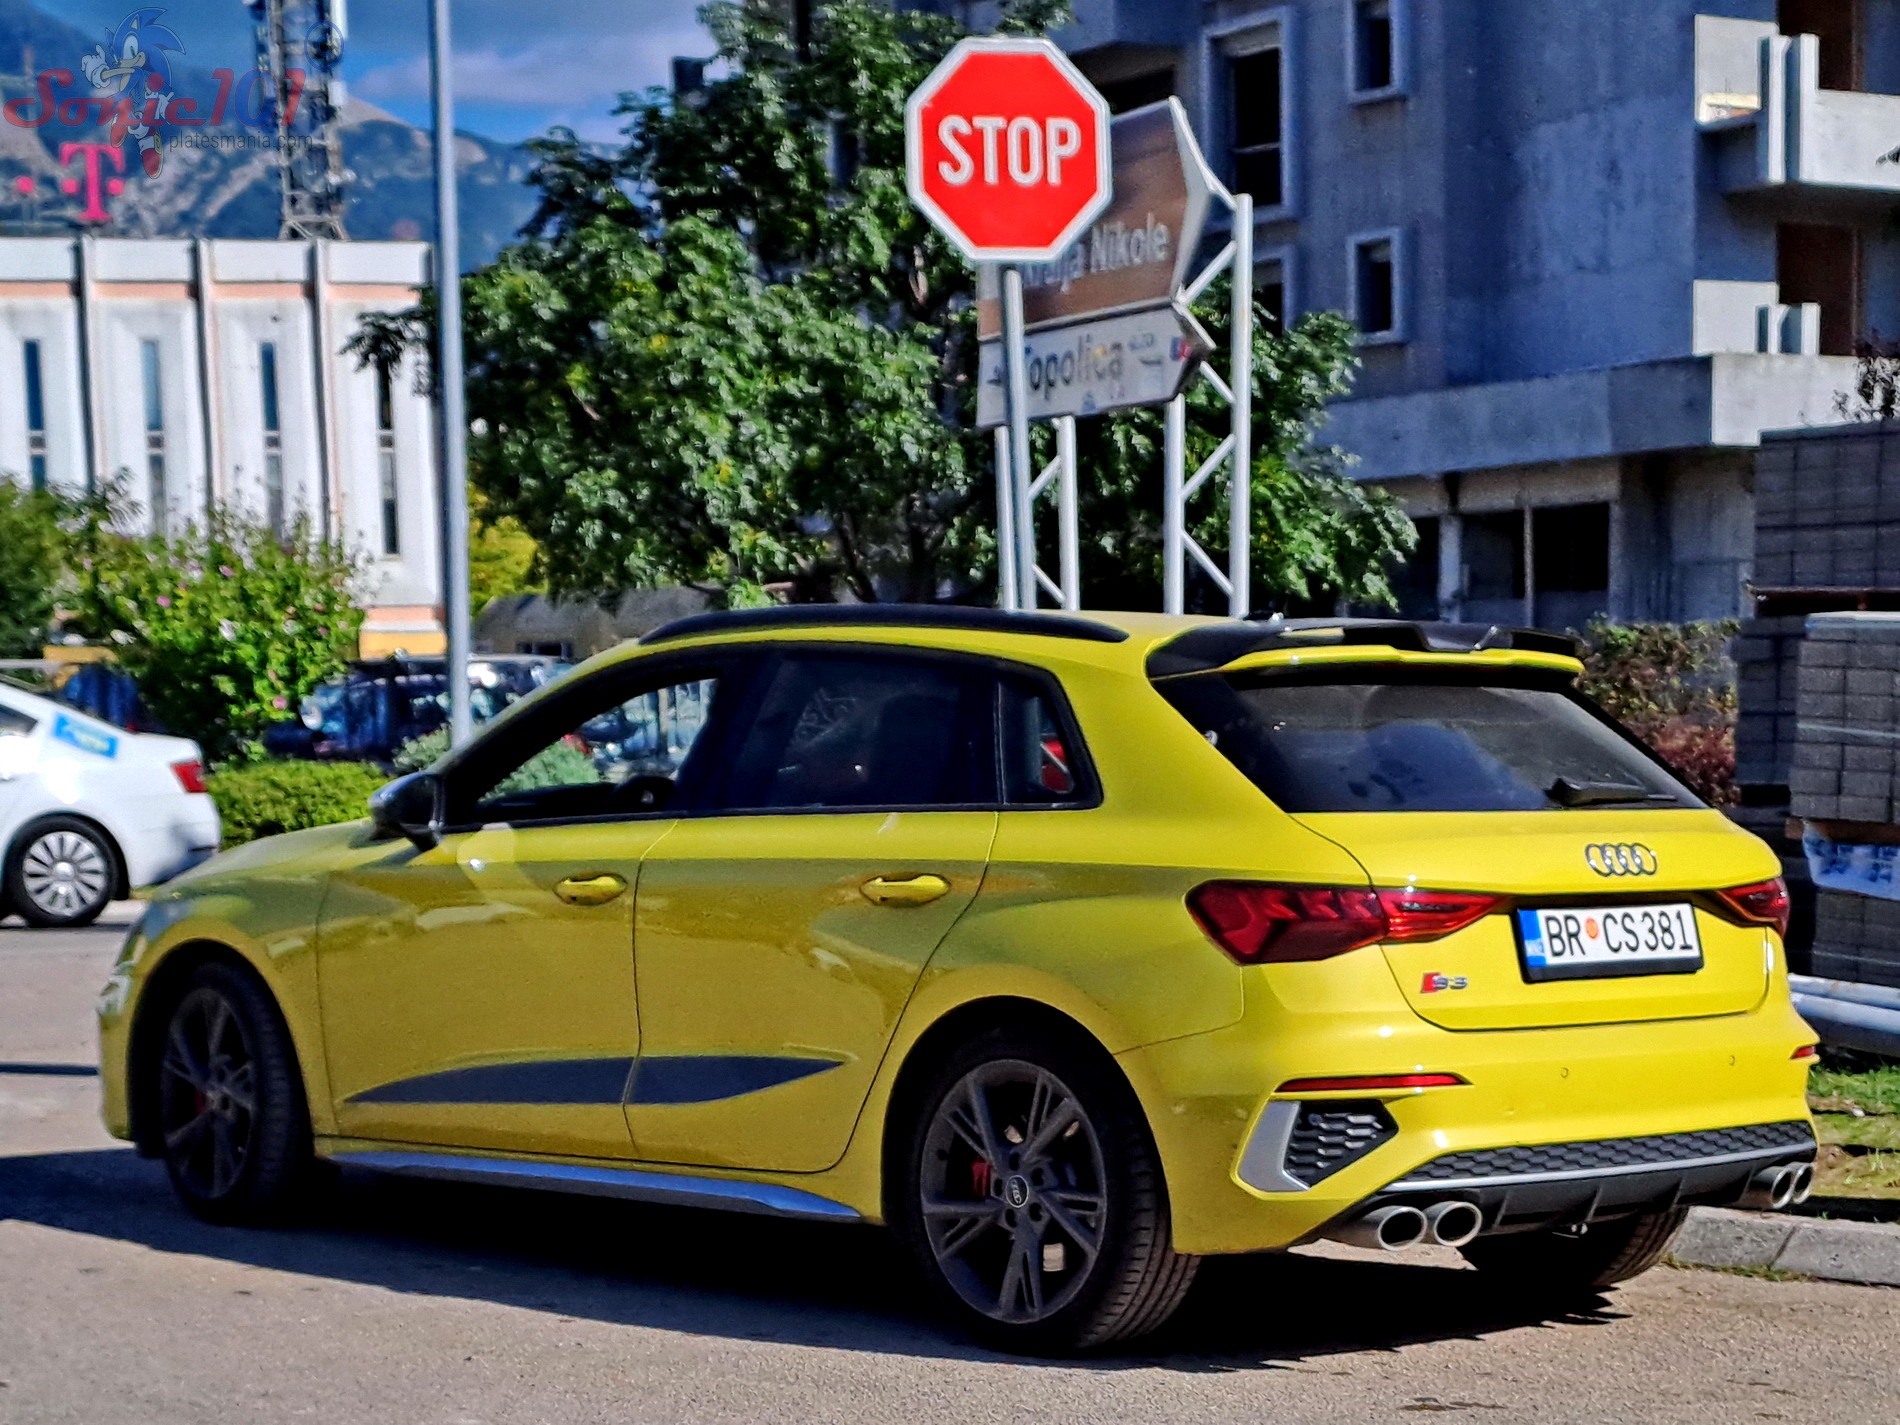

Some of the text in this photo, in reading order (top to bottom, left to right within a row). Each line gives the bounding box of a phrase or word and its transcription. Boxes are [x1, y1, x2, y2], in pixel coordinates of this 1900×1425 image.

[59, 142, 125, 222] T
[938, 114, 1082, 187] STOP
[1091, 212, 1169, 274] Nikole
[1024, 334, 1123, 400] opolica
[1544, 910, 1693, 957] BR CS381
[1429, 974, 1468, 991] S3
